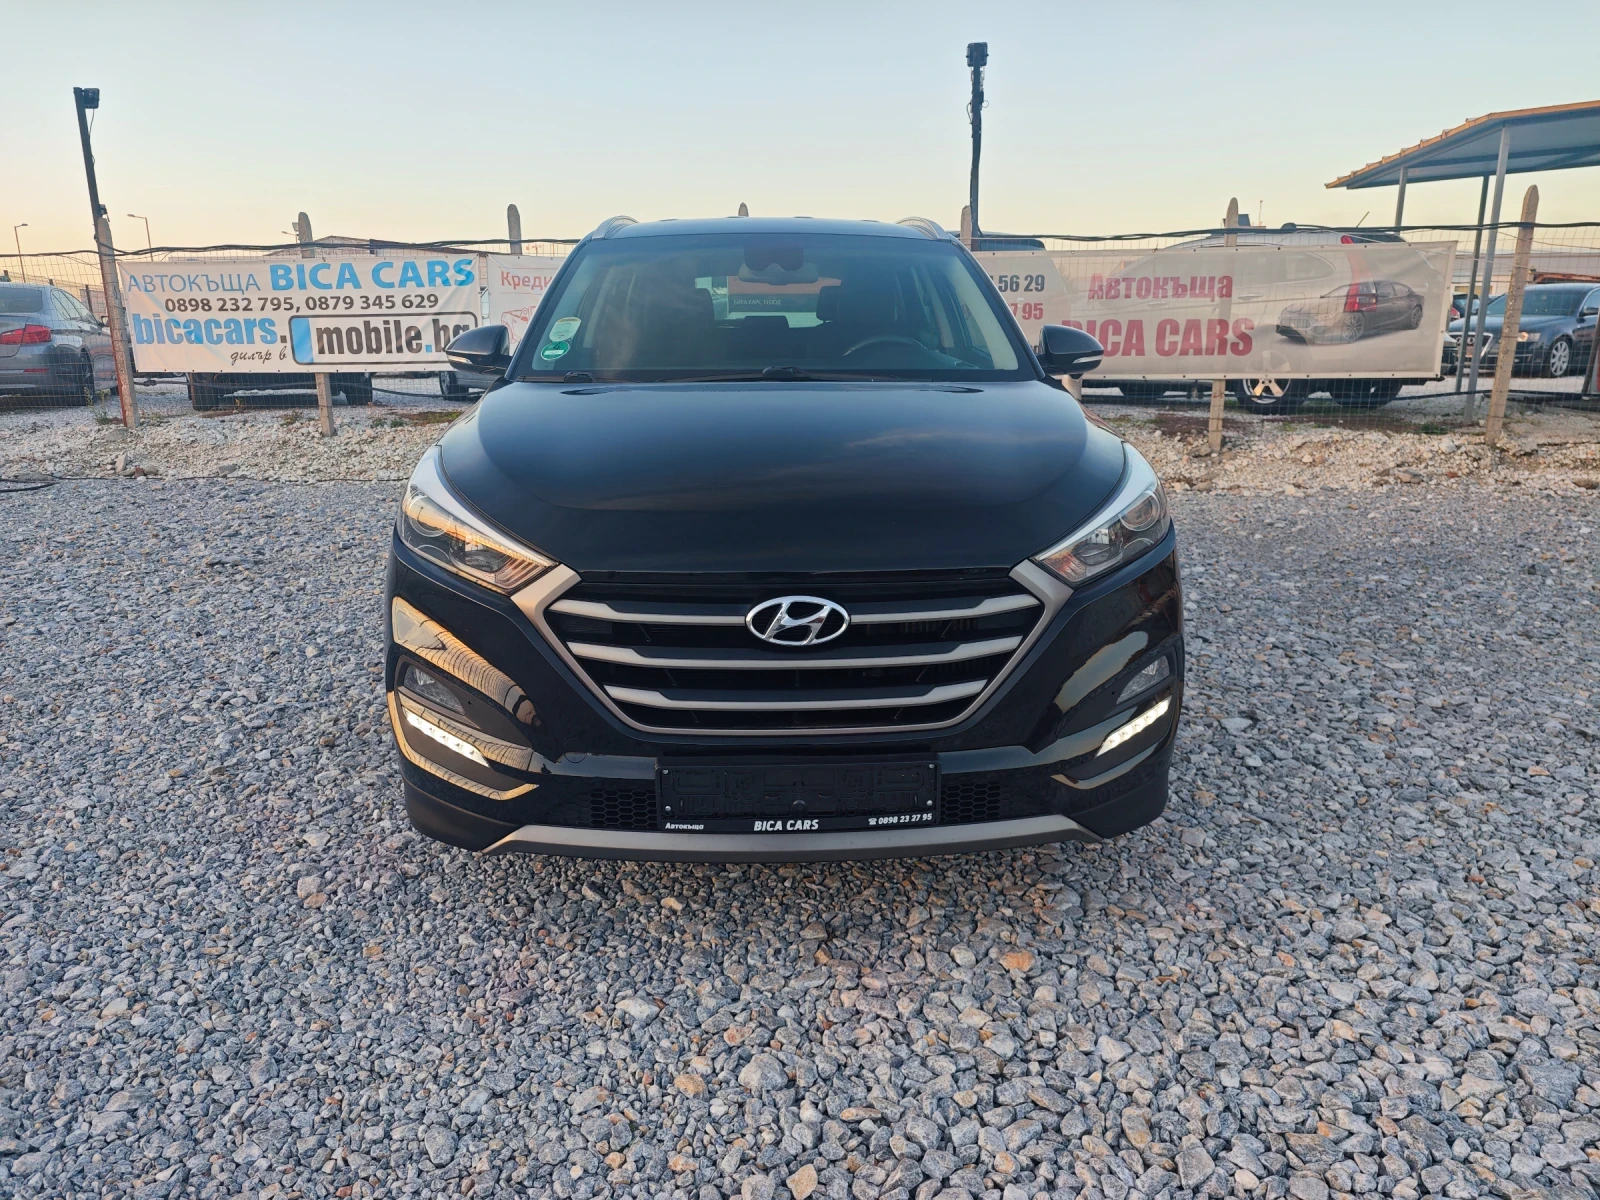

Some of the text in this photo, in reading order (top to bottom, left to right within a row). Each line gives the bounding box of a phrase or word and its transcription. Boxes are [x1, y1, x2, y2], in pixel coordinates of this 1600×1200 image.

[127, 258, 475, 295] АВТОКЪЩА BICA CARS
[998, 274, 1045, 293] 56 29
[1087, 273, 1234, 302] Автокъща
[164, 293, 439, 313] 0898 232 795, 0879 345 629
[1021, 302, 1044, 321] 95
[1155, 317, 1255, 357] CARS
[665, 822, 705, 831] Автокъща
[753, 819, 819, 831] BICA CARS
[878, 813, 933, 825] 0898 23 27 95
